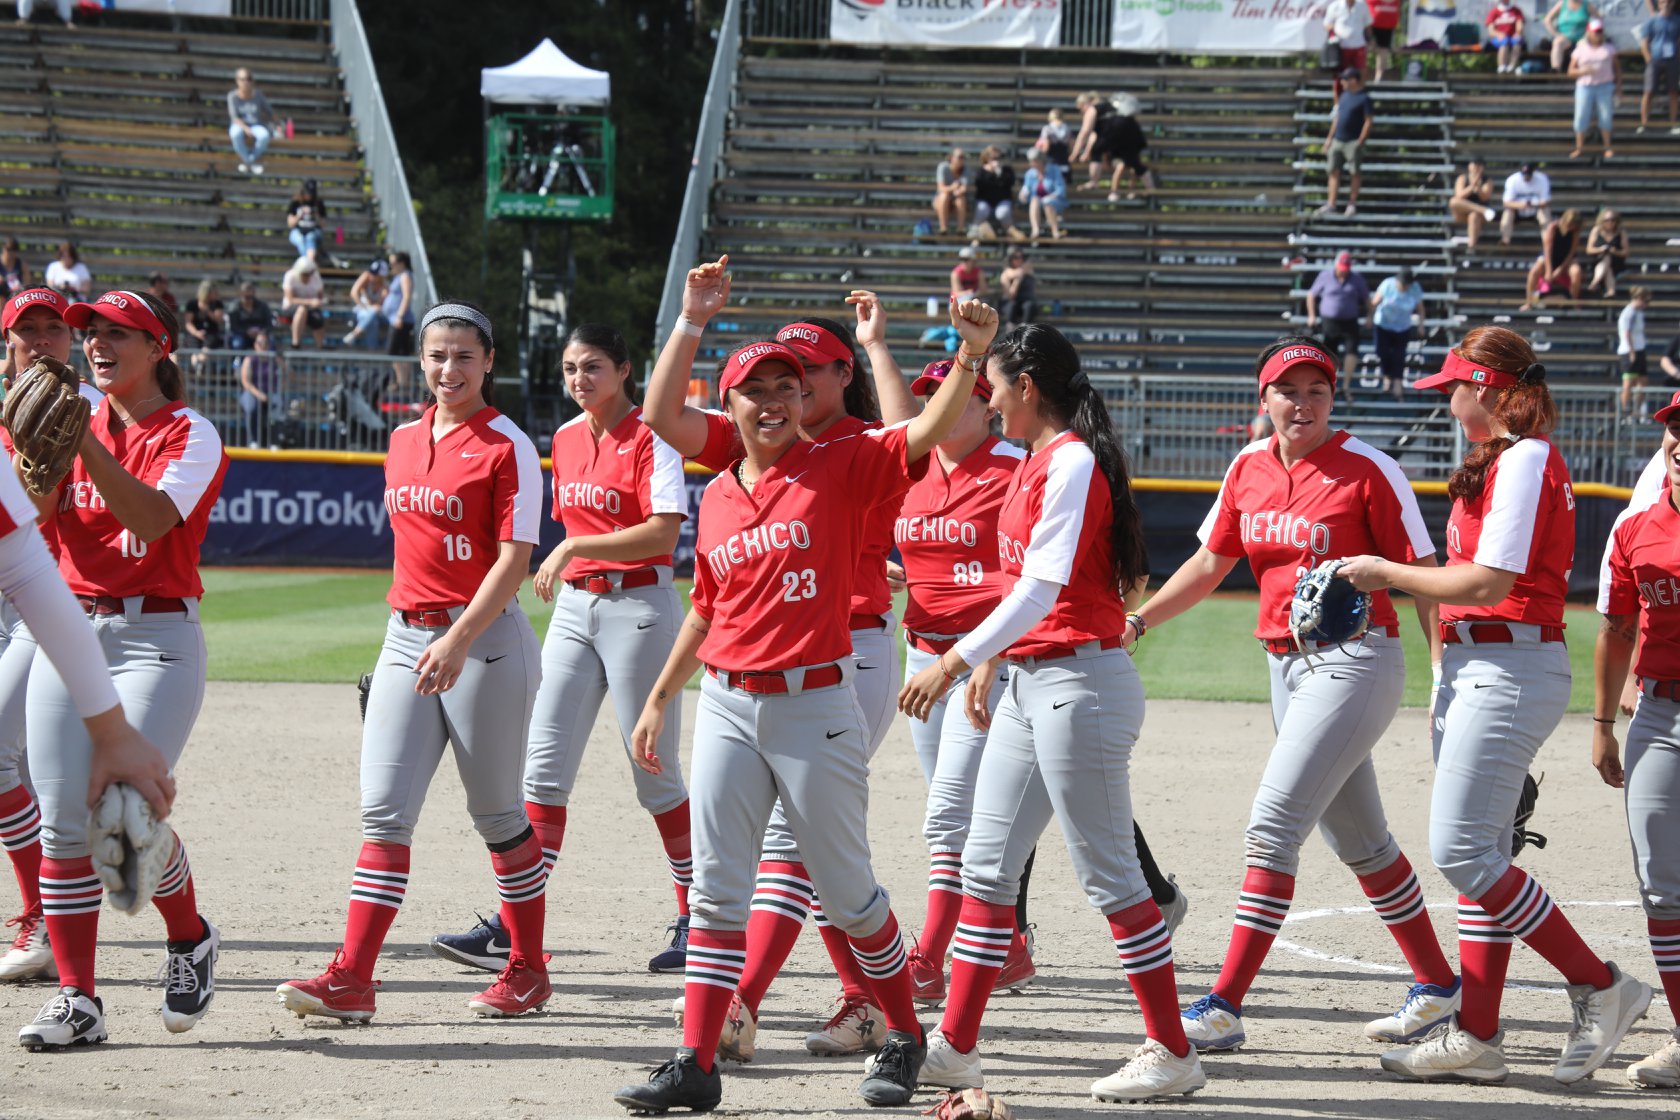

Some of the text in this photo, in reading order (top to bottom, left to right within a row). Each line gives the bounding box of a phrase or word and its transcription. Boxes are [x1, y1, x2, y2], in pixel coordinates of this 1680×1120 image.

[1232, 0, 1265, 19] Tim
[14, 294, 57, 309] MEXICO
[779, 327, 819, 344] MEXICO
[1283, 348, 1325, 362] MEXICO
[384, 485, 463, 521] MEXICO
[558, 482, 621, 514] MEXICO
[119, 528, 149, 558] 10
[895, 516, 977, 547] MEXICO
[1240, 510, 1330, 555] MEXICO
[443, 534, 472, 561] 16
[707, 520, 810, 581] MEXICO
[782, 568, 817, 602] 23
[953, 560, 984, 586] 89
